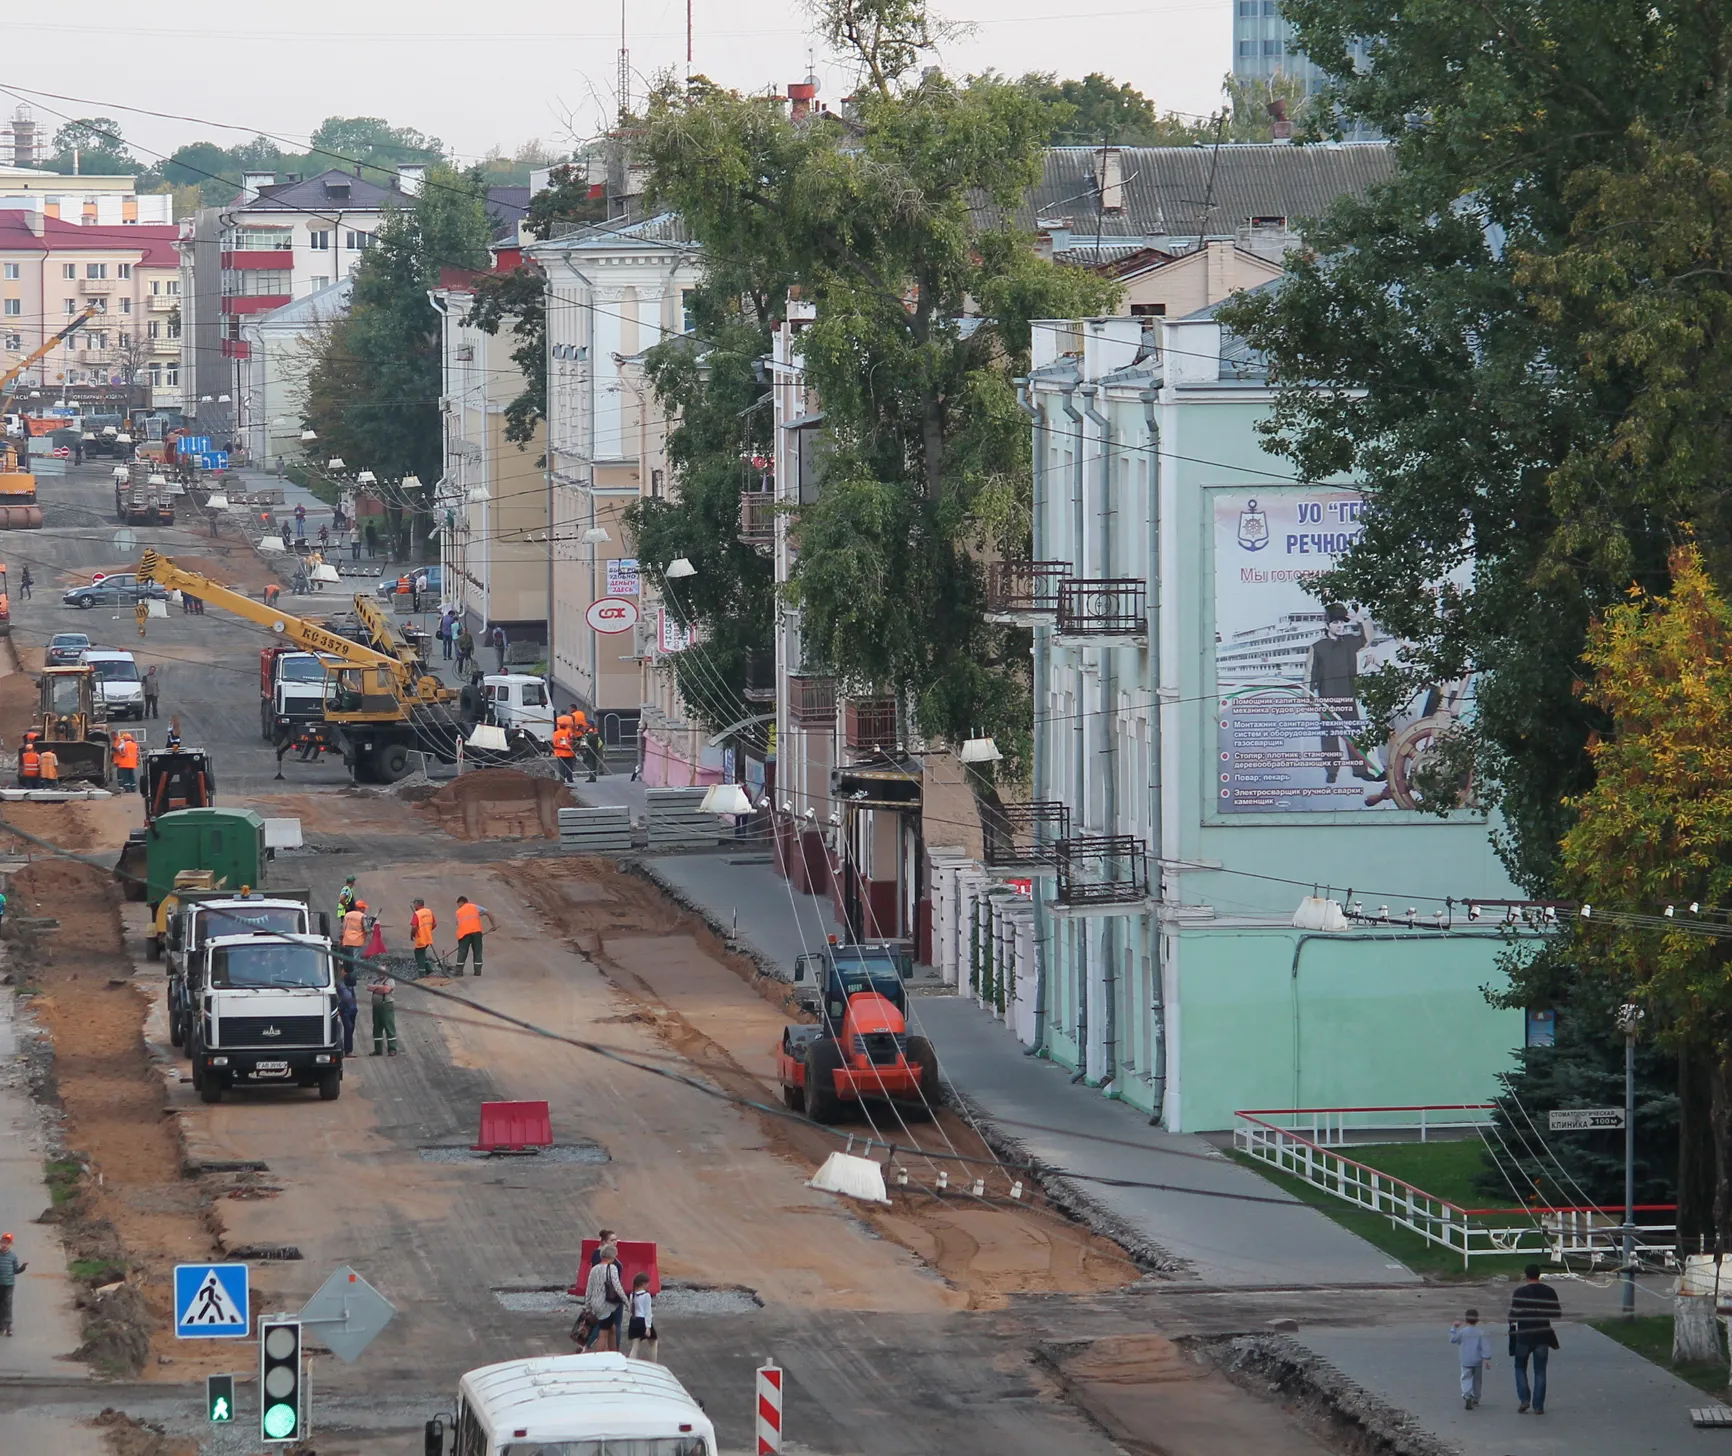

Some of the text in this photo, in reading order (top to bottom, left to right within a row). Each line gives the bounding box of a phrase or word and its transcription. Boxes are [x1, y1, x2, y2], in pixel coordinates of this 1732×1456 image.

[1298, 503, 1321, 524] УО
[1240, 568, 1268, 583] Мы
[320, 636, 349, 655] 3579
[1271, 707, 1294, 715] судов
[1296, 706, 1327, 714] речного
[1328, 705, 1353, 713] флота
[1234, 740, 1284, 748] газосварщик
[1234, 789, 1301, 797] Электросварщик
[1302, 787, 1331, 796] ручной
[1234, 798, 1274, 806] каменщик
[1551, 1121, 1588, 1129] КЛИНИКА
